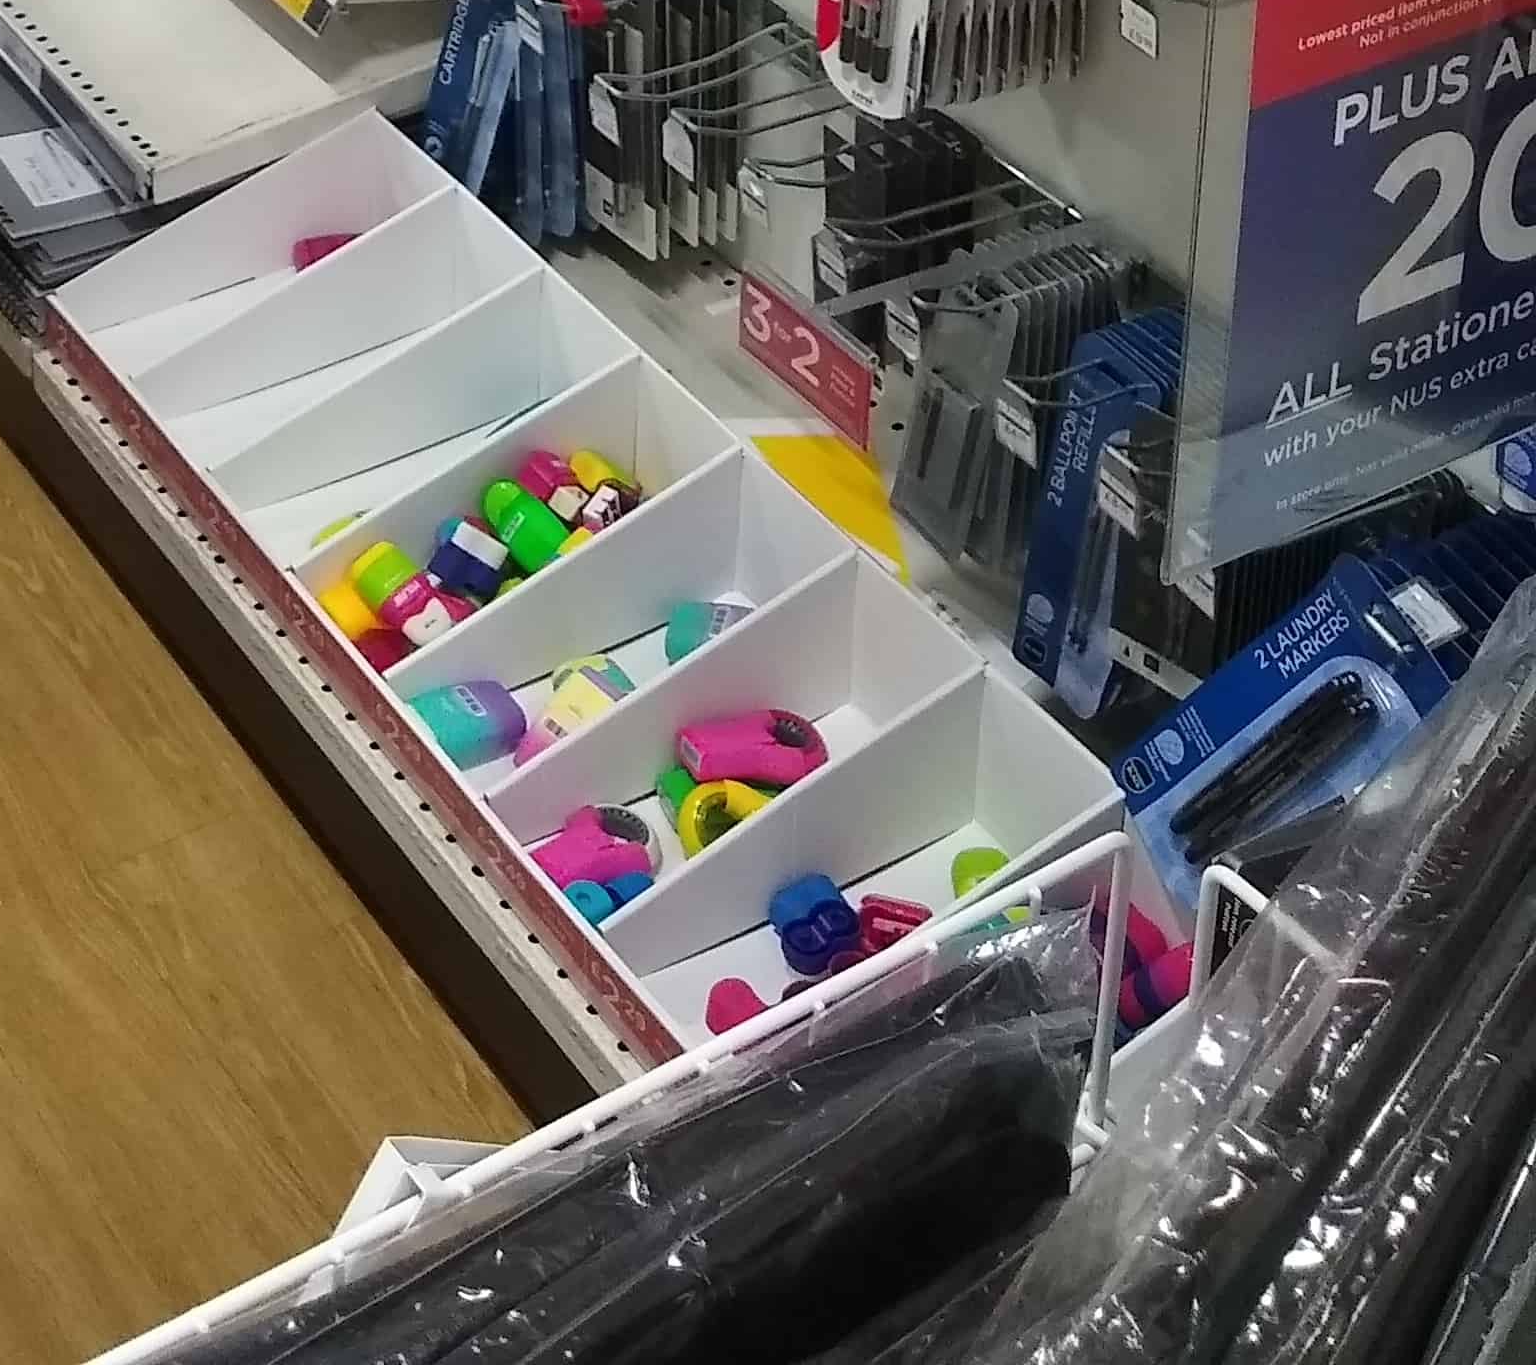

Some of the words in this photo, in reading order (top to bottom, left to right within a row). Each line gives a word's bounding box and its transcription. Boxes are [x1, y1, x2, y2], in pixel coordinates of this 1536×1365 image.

[1298, 22, 1349, 51] Lowest
[1351, 7, 1395, 35] priced
[1359, 29, 1384, 49] Not
[1388, 24, 1400, 38] in
[1334, 53, 1471, 146] PLUS
[744, 283, 771, 342] 3
[791, 327, 820, 388] 2
[1264, 430, 1317, 468] with
[1326, 404, 1382, 447] your
[1390, 376, 1441, 416] NUS
[1450, 352, 1509, 390] extra
[1265, 362, 1353, 424] ALL
[1048, 492, 1063, 508] 2
[1253, 648, 1271, 670] 2
[1264, 589, 1336, 660] LAUNDRY
[1276, 610, 1351, 680] MARKERS
